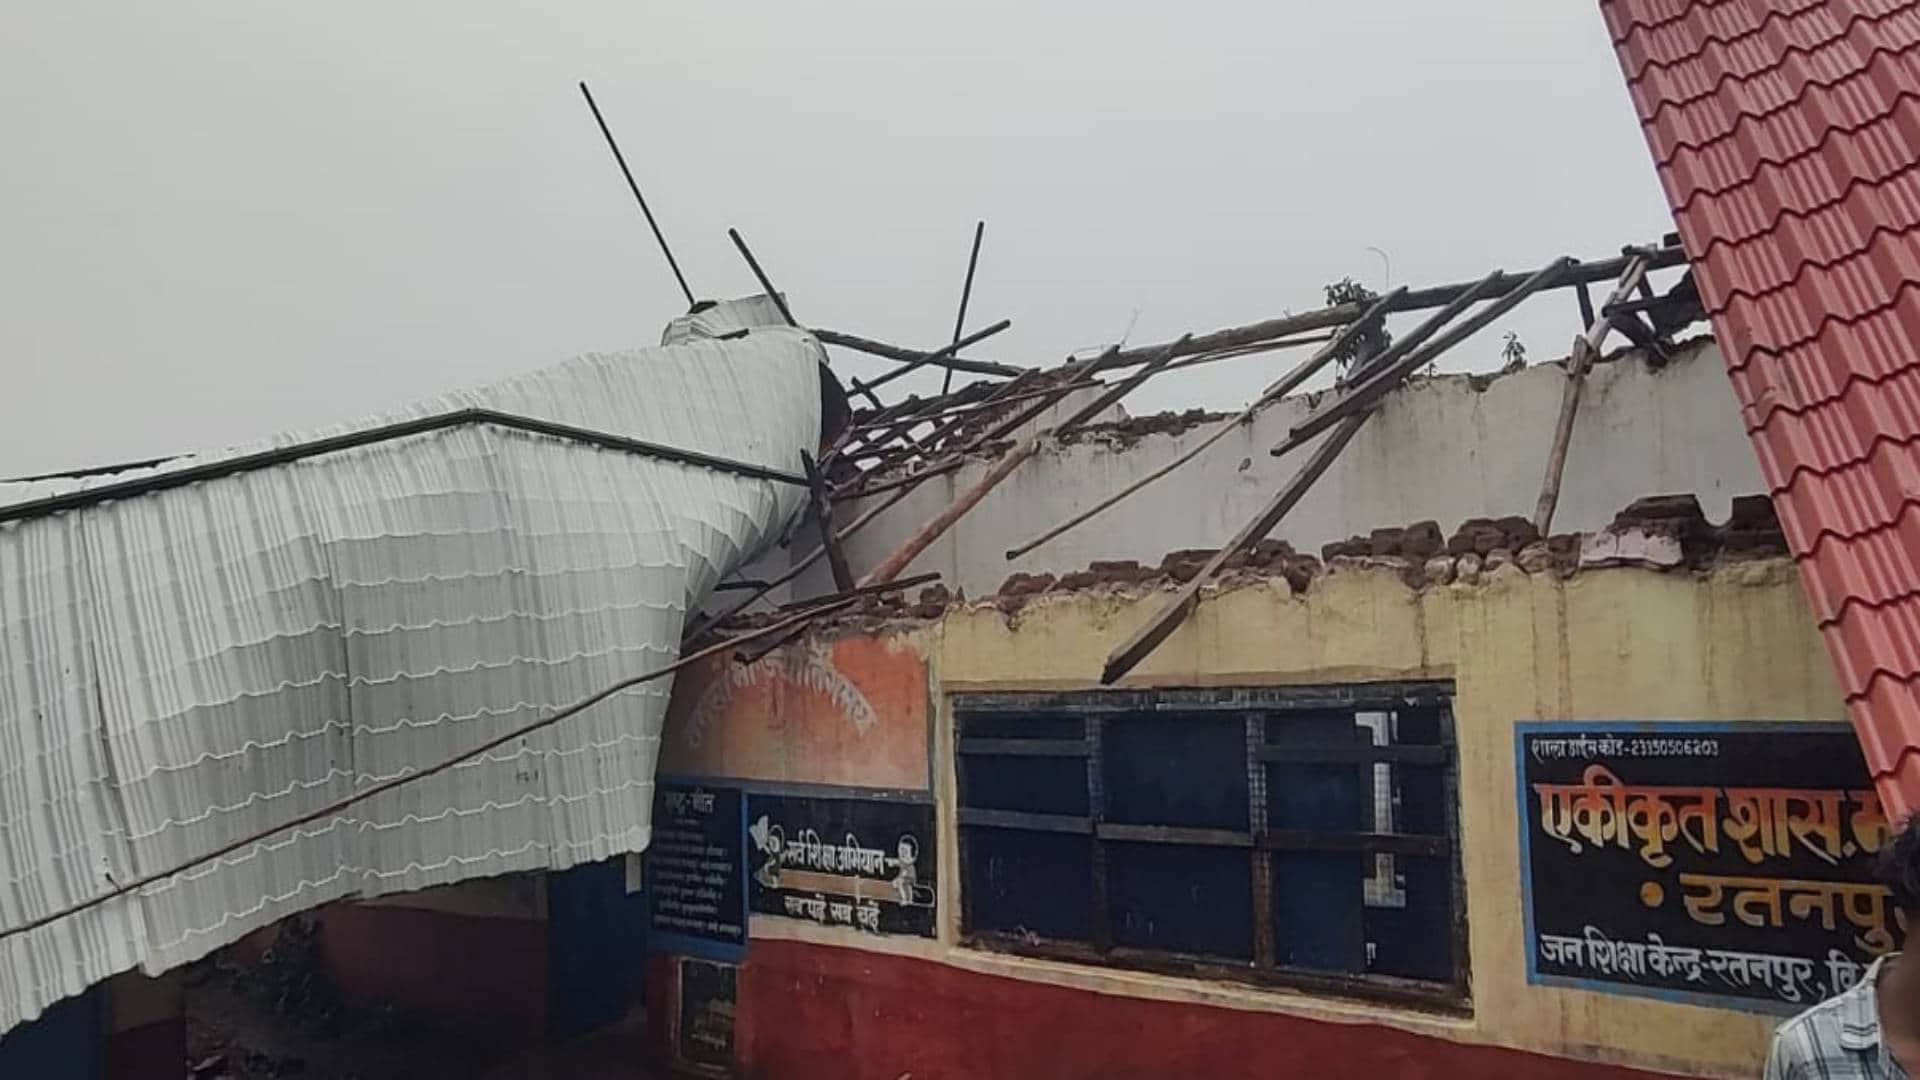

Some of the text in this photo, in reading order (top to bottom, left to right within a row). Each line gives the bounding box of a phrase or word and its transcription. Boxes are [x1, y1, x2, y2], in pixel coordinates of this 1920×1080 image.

[1533, 763, 1723, 868] एकीकृत
[786, 828, 886, 876] सर्व शिक्षा अभियान
[829, 901, 854, 925] सब
[1679, 872, 1905, 956] रतनपु
[1540, 934, 1584, 969] जन
[1584, 926, 1646, 982] शिक्षा
